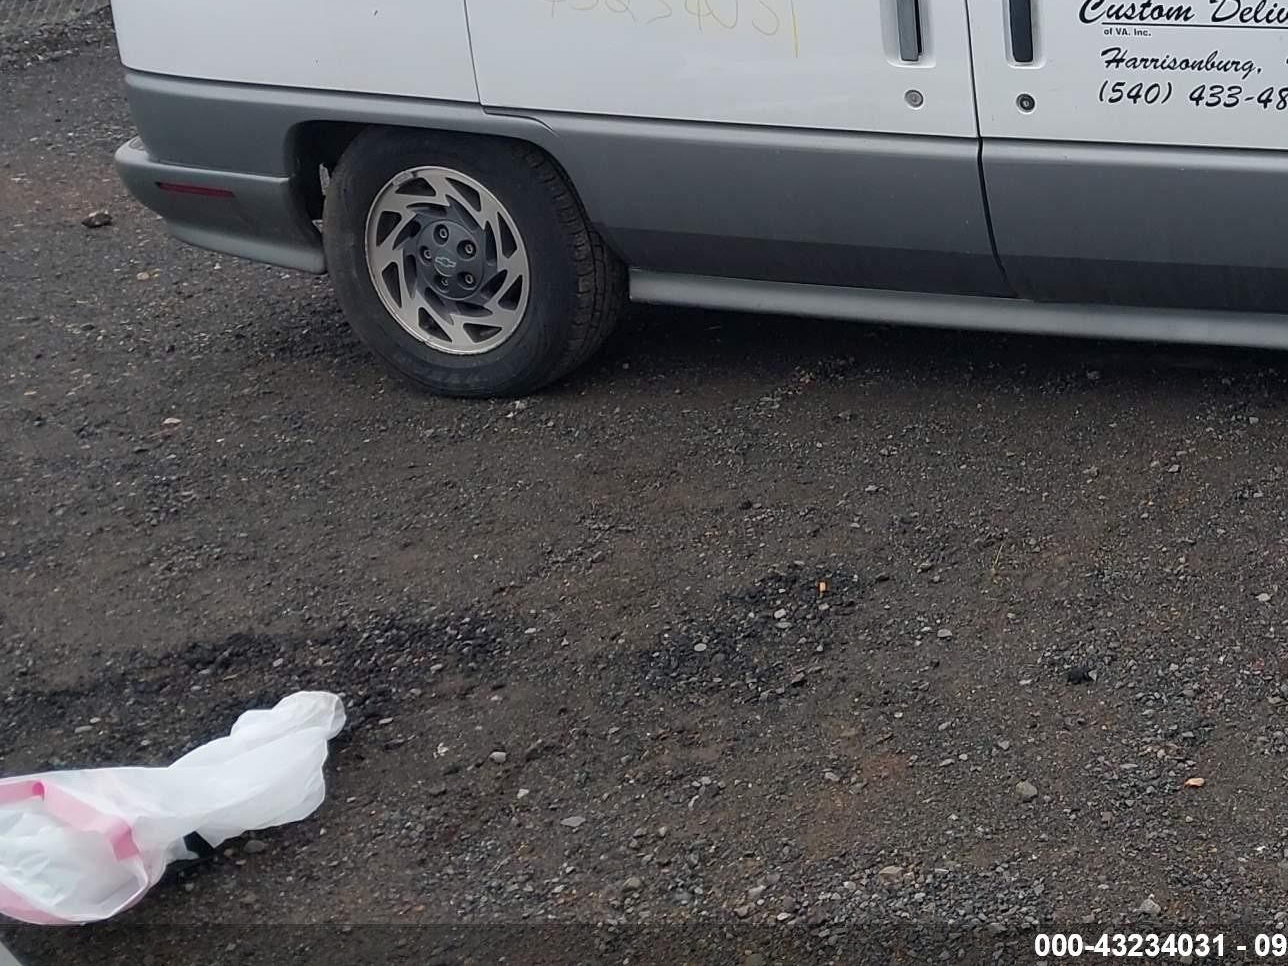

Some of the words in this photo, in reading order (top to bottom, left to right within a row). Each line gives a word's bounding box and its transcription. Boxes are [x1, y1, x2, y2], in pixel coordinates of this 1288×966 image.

[1133, 27, 1152, 37] Inc.
[1100, 47, 1262, 80] Harrisonburg,
[1098, 80, 1174, 104] (540)
